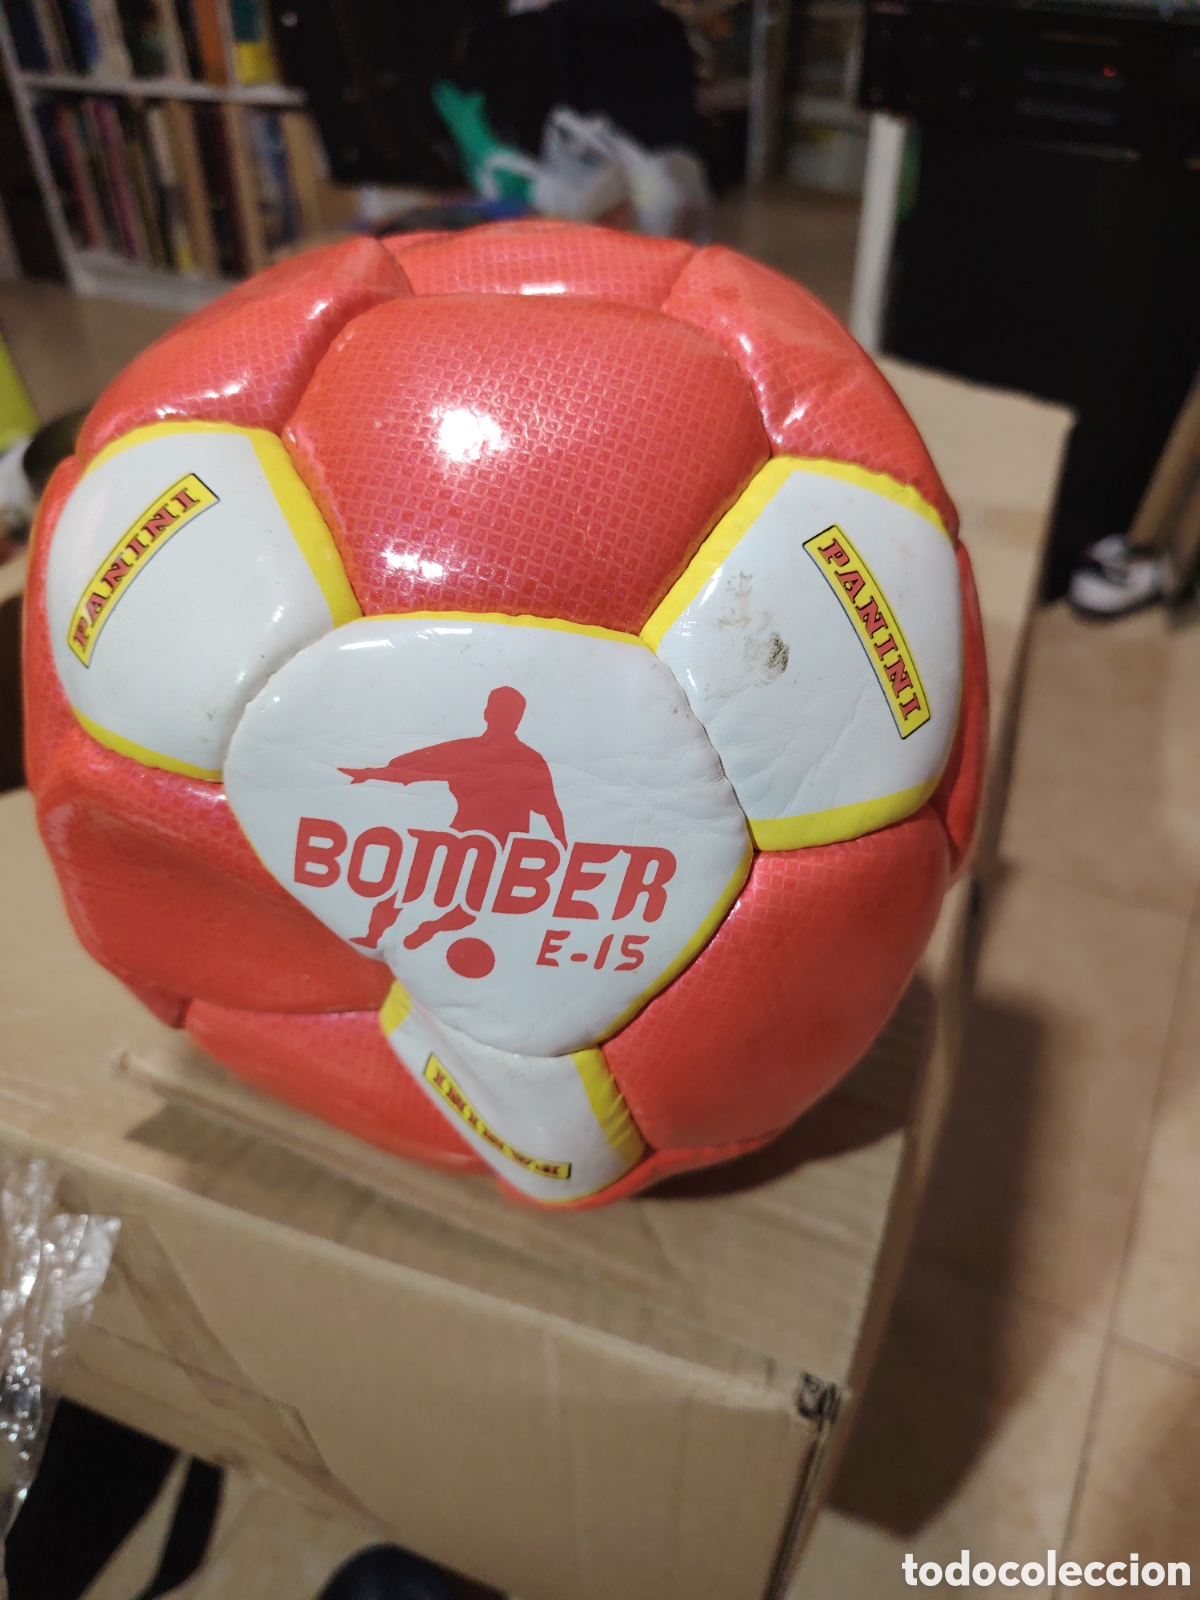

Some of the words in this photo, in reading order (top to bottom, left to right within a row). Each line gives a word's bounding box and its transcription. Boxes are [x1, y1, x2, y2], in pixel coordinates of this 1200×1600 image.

[73, 487, 201, 653] PANINI
[818, 538, 921, 721] PANINI
[294, 817, 677, 923] BOMBER
[536, 929, 650, 971] E-15
